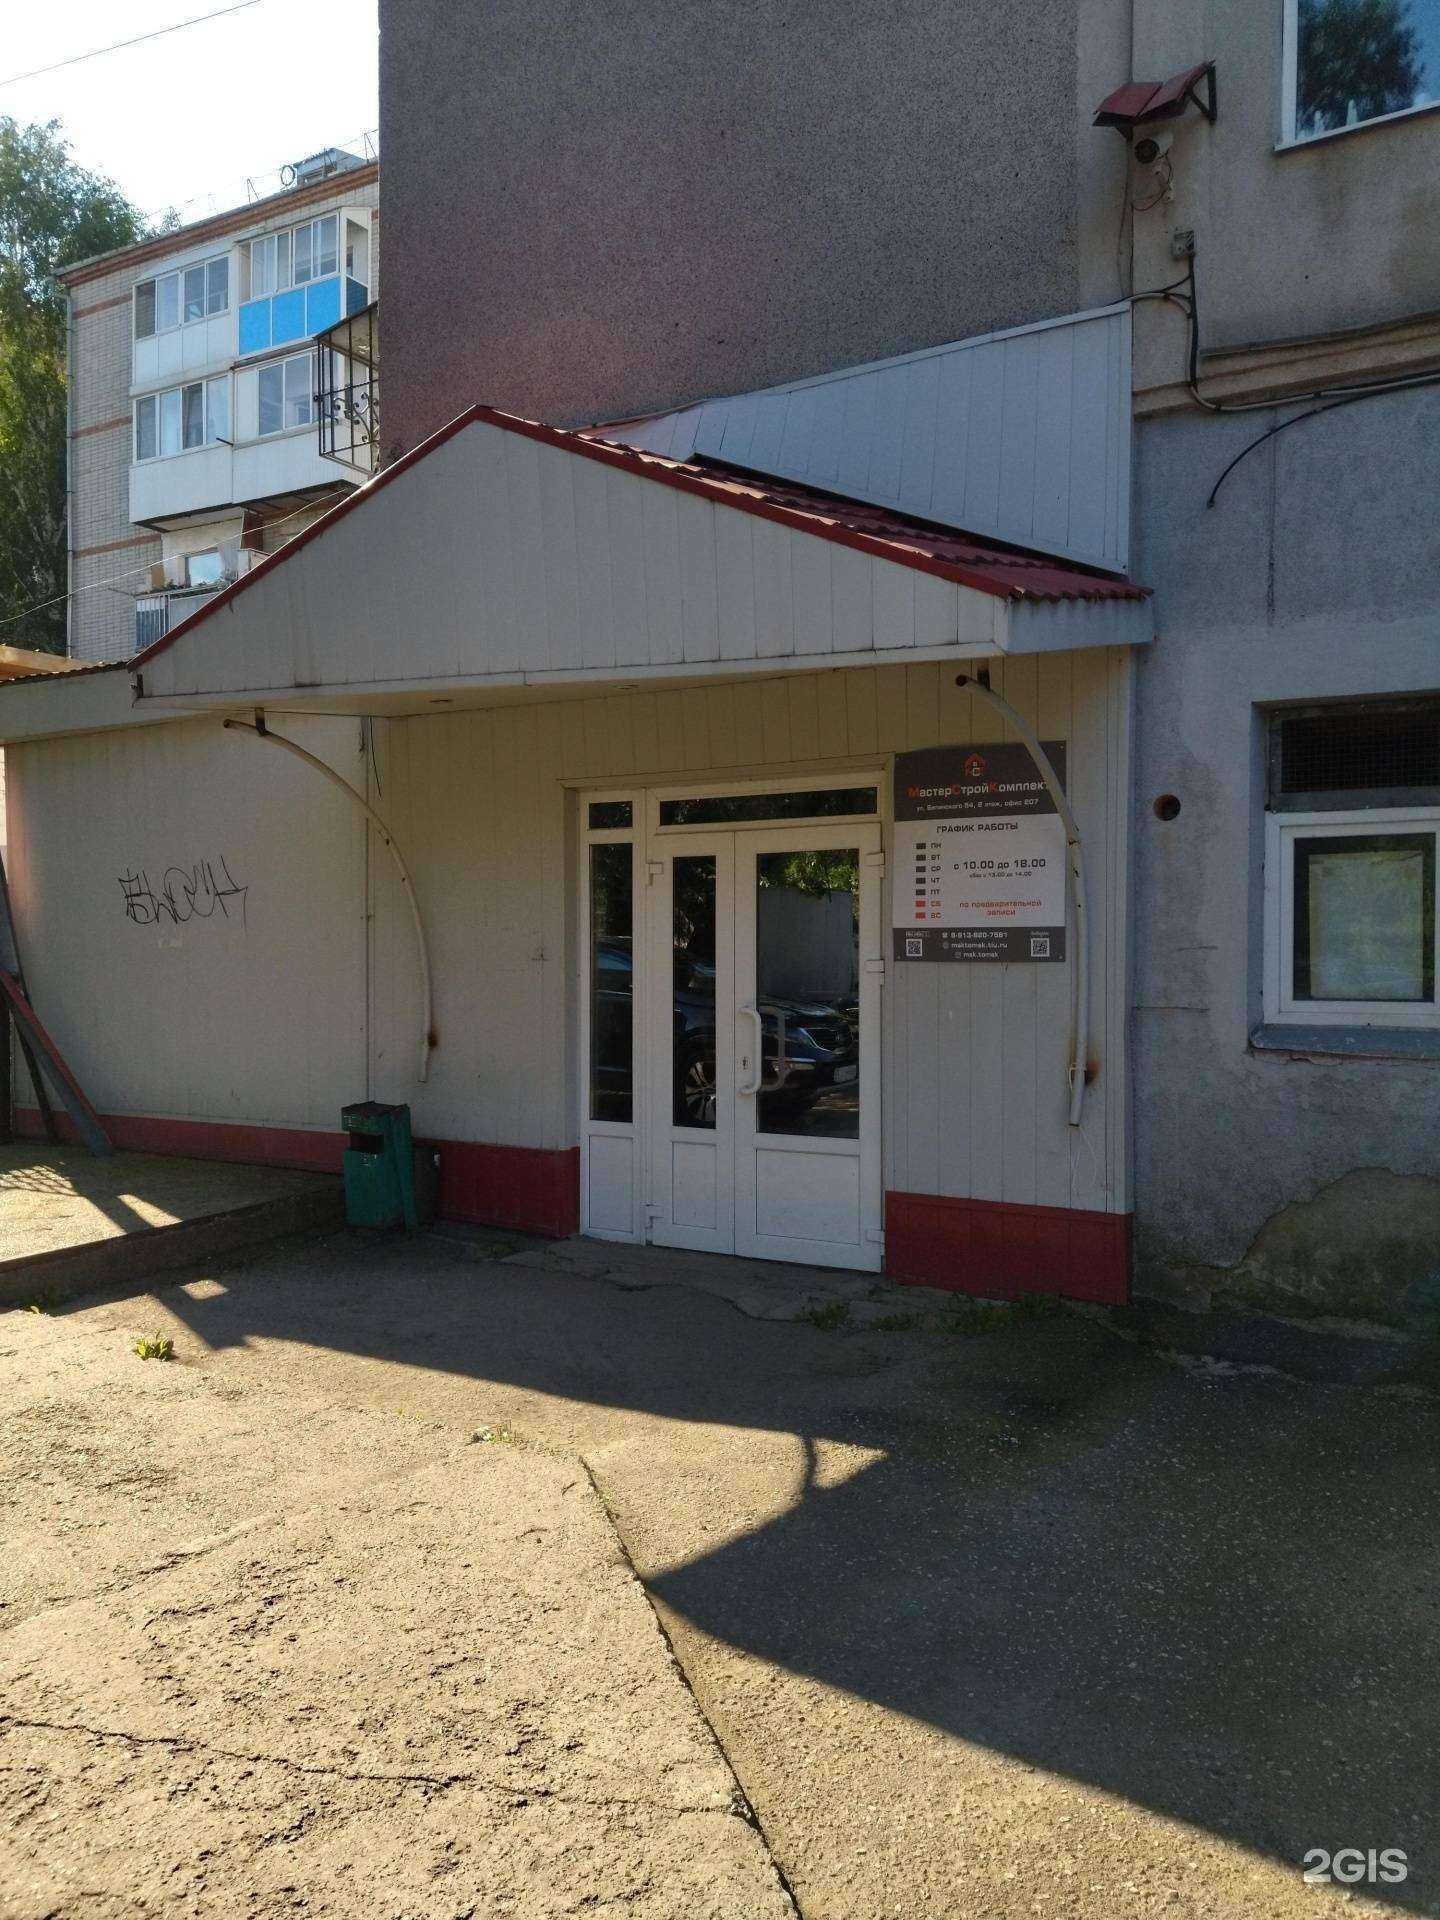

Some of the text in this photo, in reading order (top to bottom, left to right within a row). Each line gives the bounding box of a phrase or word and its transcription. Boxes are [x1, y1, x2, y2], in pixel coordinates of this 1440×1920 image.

[1024, 798, 1039, 806] 207
[936, 822, 1018, 834] ГРАФИК РАБОТЫ
[963, 860, 995, 870] 10.00
[998, 861, 1010, 870] до
[1014, 858, 1046, 868] 18.00
[971, 900, 1042, 908] предварительной
